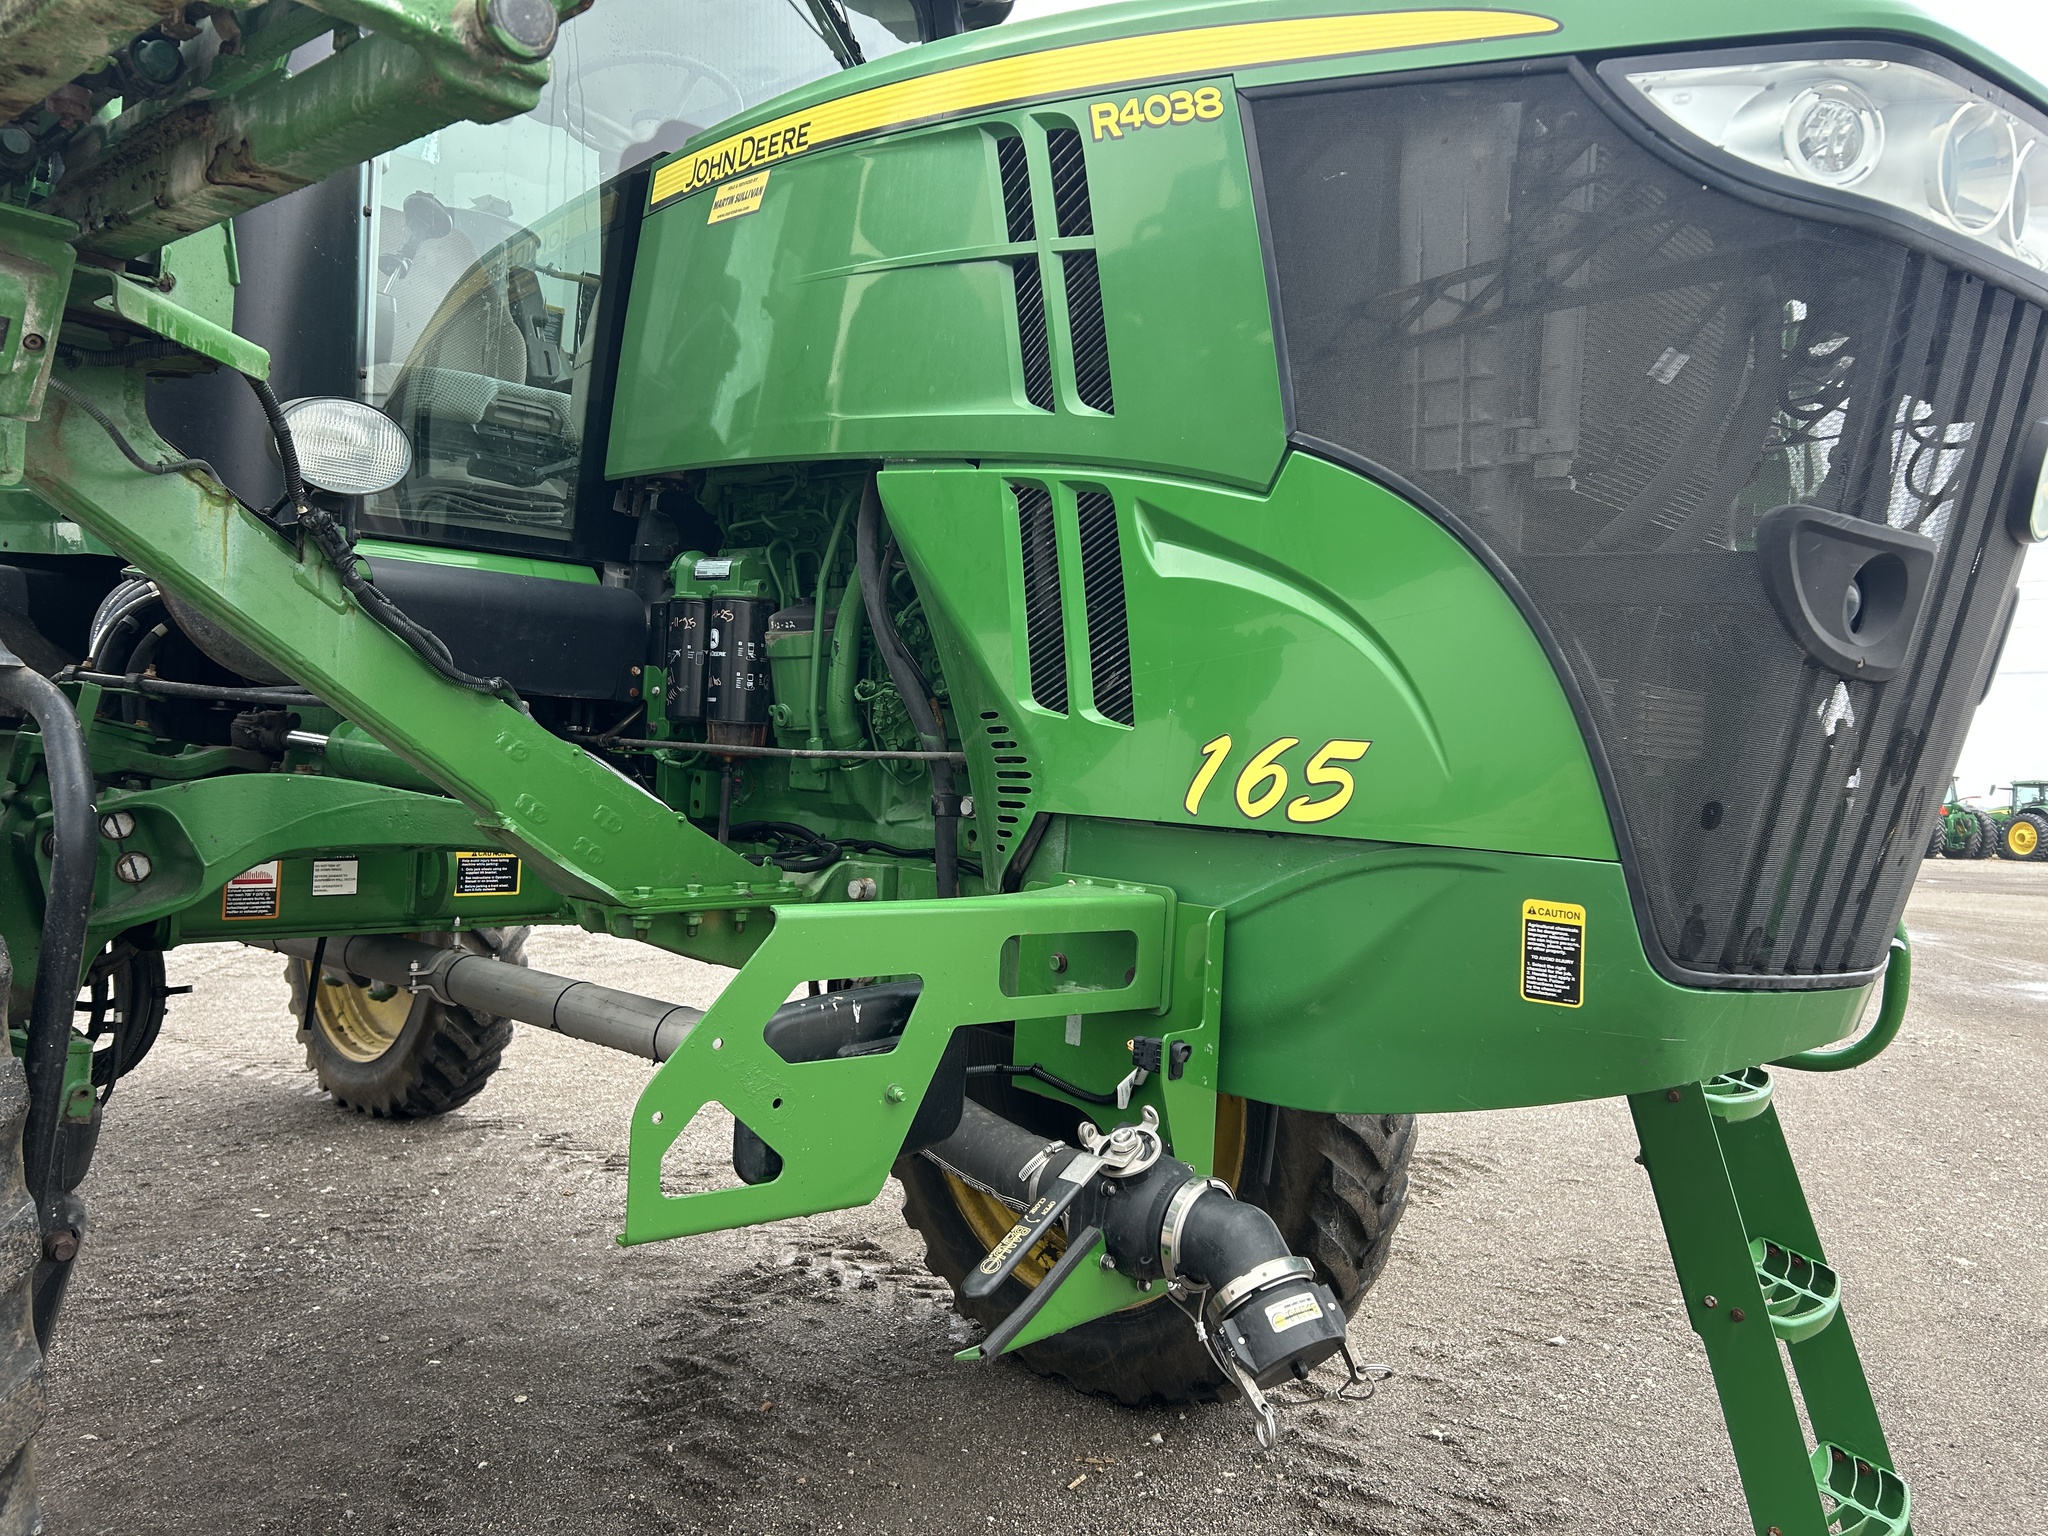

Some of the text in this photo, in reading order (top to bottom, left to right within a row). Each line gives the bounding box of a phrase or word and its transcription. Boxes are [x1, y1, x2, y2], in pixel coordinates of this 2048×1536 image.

[1089, 86, 1224, 142] R4038
[686, 122, 811, 188] JOHN DEERE
[713, 186, 764, 210] MARTIN SULLIVAN
[1183, 733, 1373, 824] 165
[1538, 907, 1581, 920] CAUTION
[1029, 1198, 1046, 1214] CLOSE
[1041, 1201, 1056, 1216] OPEN
[980, 1224, 1032, 1274] BANJO
